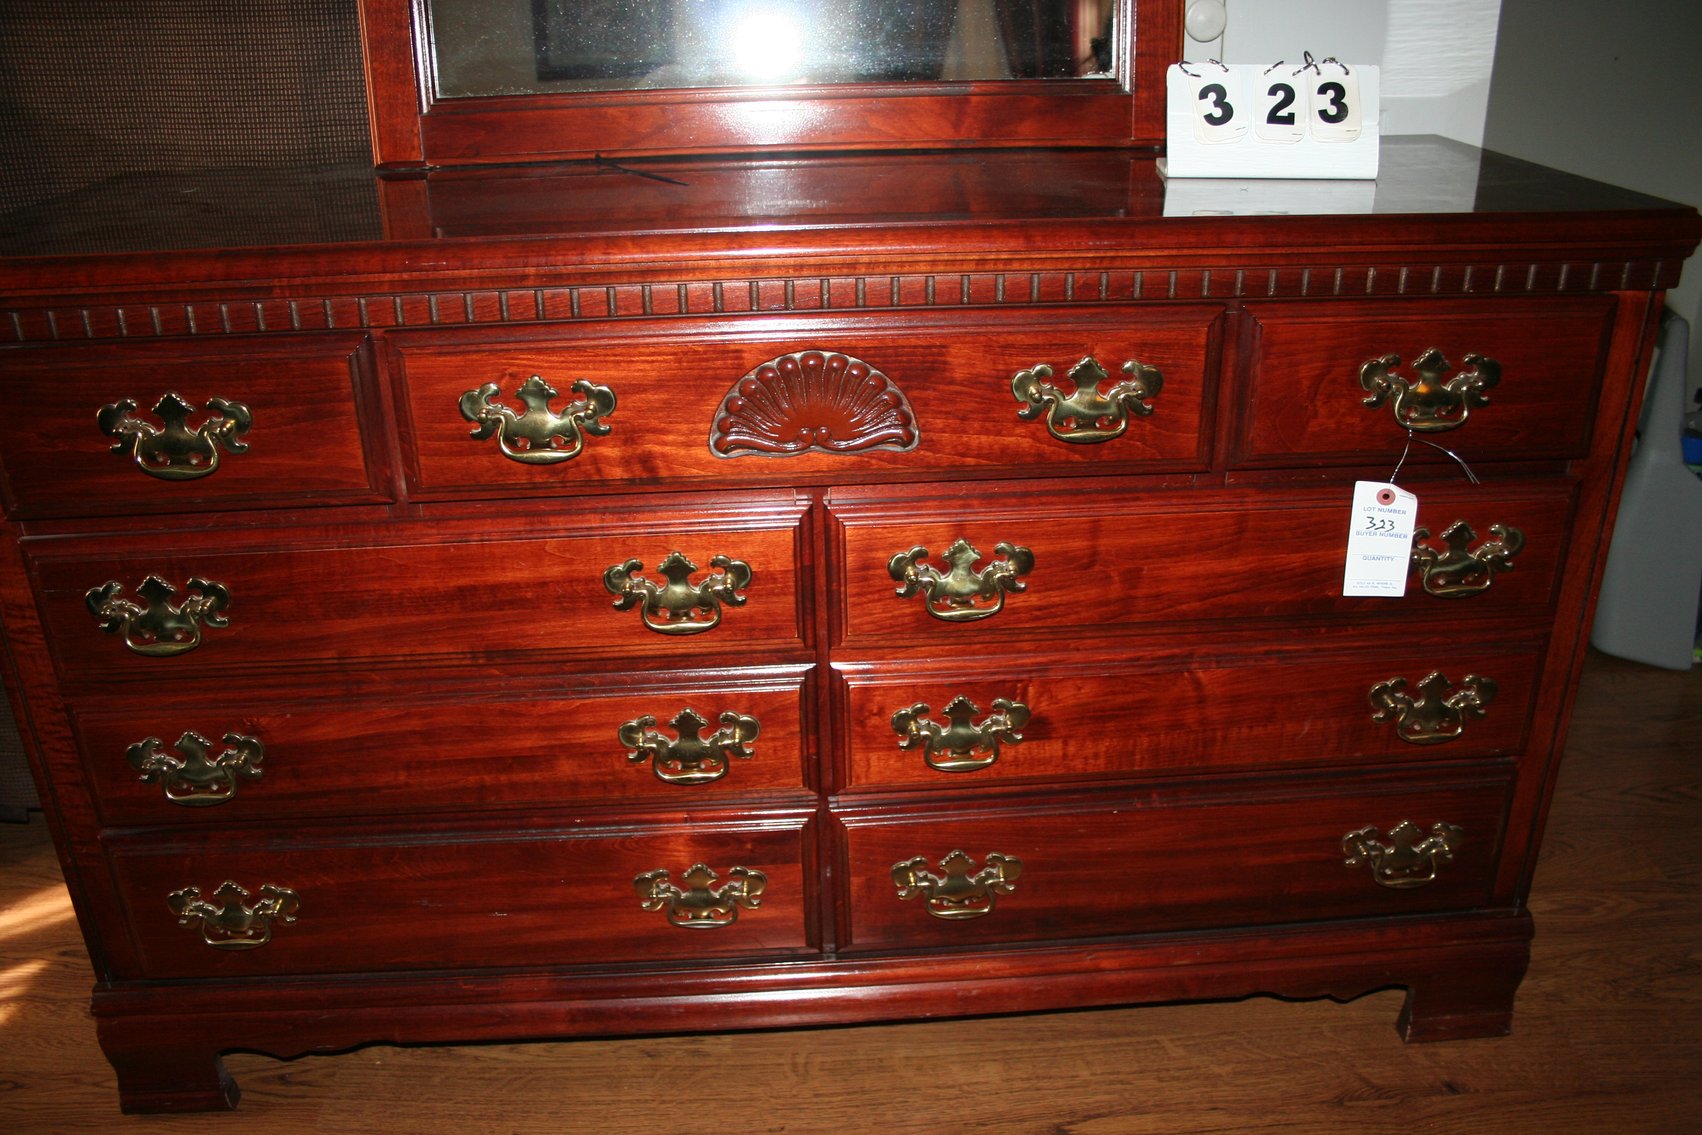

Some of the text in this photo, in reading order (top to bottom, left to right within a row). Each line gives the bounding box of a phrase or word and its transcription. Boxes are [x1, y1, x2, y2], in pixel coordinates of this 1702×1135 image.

[1378, 507, 1406, 515] NUMBER
[1365, 516, 1396, 532] 323
[1379, 531, 1408, 539] NUMBER
